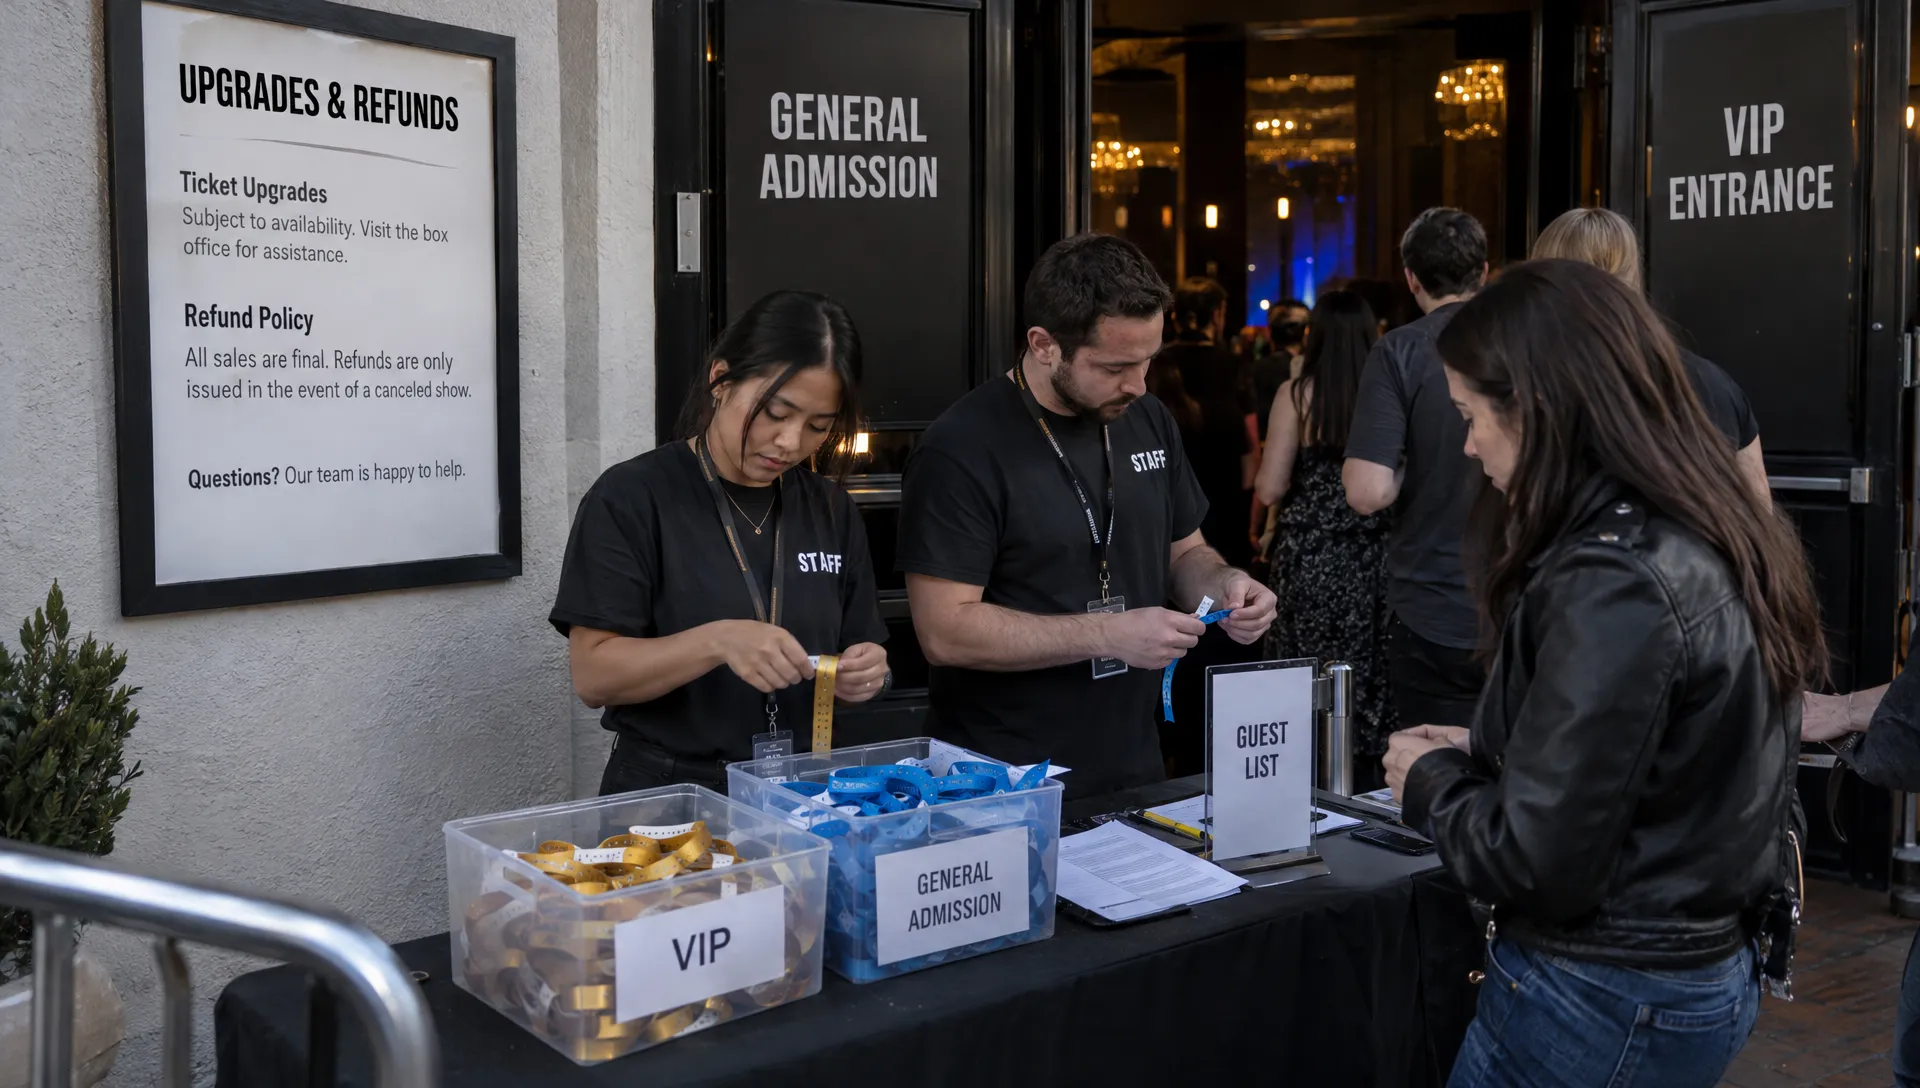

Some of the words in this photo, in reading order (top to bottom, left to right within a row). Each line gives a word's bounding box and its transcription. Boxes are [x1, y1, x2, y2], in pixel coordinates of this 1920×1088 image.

[180, 63, 319, 116] UPGRADES
[328, 82, 346, 119] &
[354, 84, 458, 131] REFUNDS
[771, 92, 927, 142] GENERAL
[1724, 103, 1784, 156] VIP
[180, 171, 237, 196] Ticket
[244, 176, 327, 204] Upgrades
[760, 154, 937, 198] ADMISSION
[1670, 165, 1833, 220] ENTRANCE
[183, 207, 245, 231] Subject
[250, 213, 266, 229] to
[272, 215, 354, 240] availability.
[360, 220, 391, 238] Visit
[396, 223, 418, 240] the
[424, 224, 448, 242] box
[184, 237, 230, 256] office
[236, 239, 258, 258] for
[264, 244, 347, 262] assistance.
[185, 303, 252, 328] Refund
[260, 306, 313, 336] Policy
[185, 347, 206, 367] All
[214, 347, 256, 367] sales
[263, 354, 287, 368] are
[292, 349, 328, 368] final.
[335, 350, 391, 369] Refunds
[397, 357, 418, 369] are
[424, 352, 453, 375] only
[187, 379, 241, 398] issued
[248, 380, 261, 398] in
[267, 380, 292, 398] the
[299, 382, 340, 398] event
[345, 380, 359, 398] of
[363, 386, 370, 398] a
[375, 381, 431, 398] canceled
[436, 382, 471, 397] show.
[189, 467, 279, 489] Questions?
[285, 466, 312, 484] Our
[317, 467, 353, 482] team
[359, 464, 369, 481] is
[375, 463, 414, 483] happy
[418, 464, 431, 478] to
[436, 460, 465, 480] help.
[1131, 450, 1165, 472] STAFF
[798, 552, 841, 574] STAFF
[1237, 721, 1288, 748] GUEST
[1246, 754, 1279, 779] LIST
[917, 860, 993, 895] GENERAL
[908, 891, 1001, 932] ADMISSION
[672, 928, 730, 971] VIP
